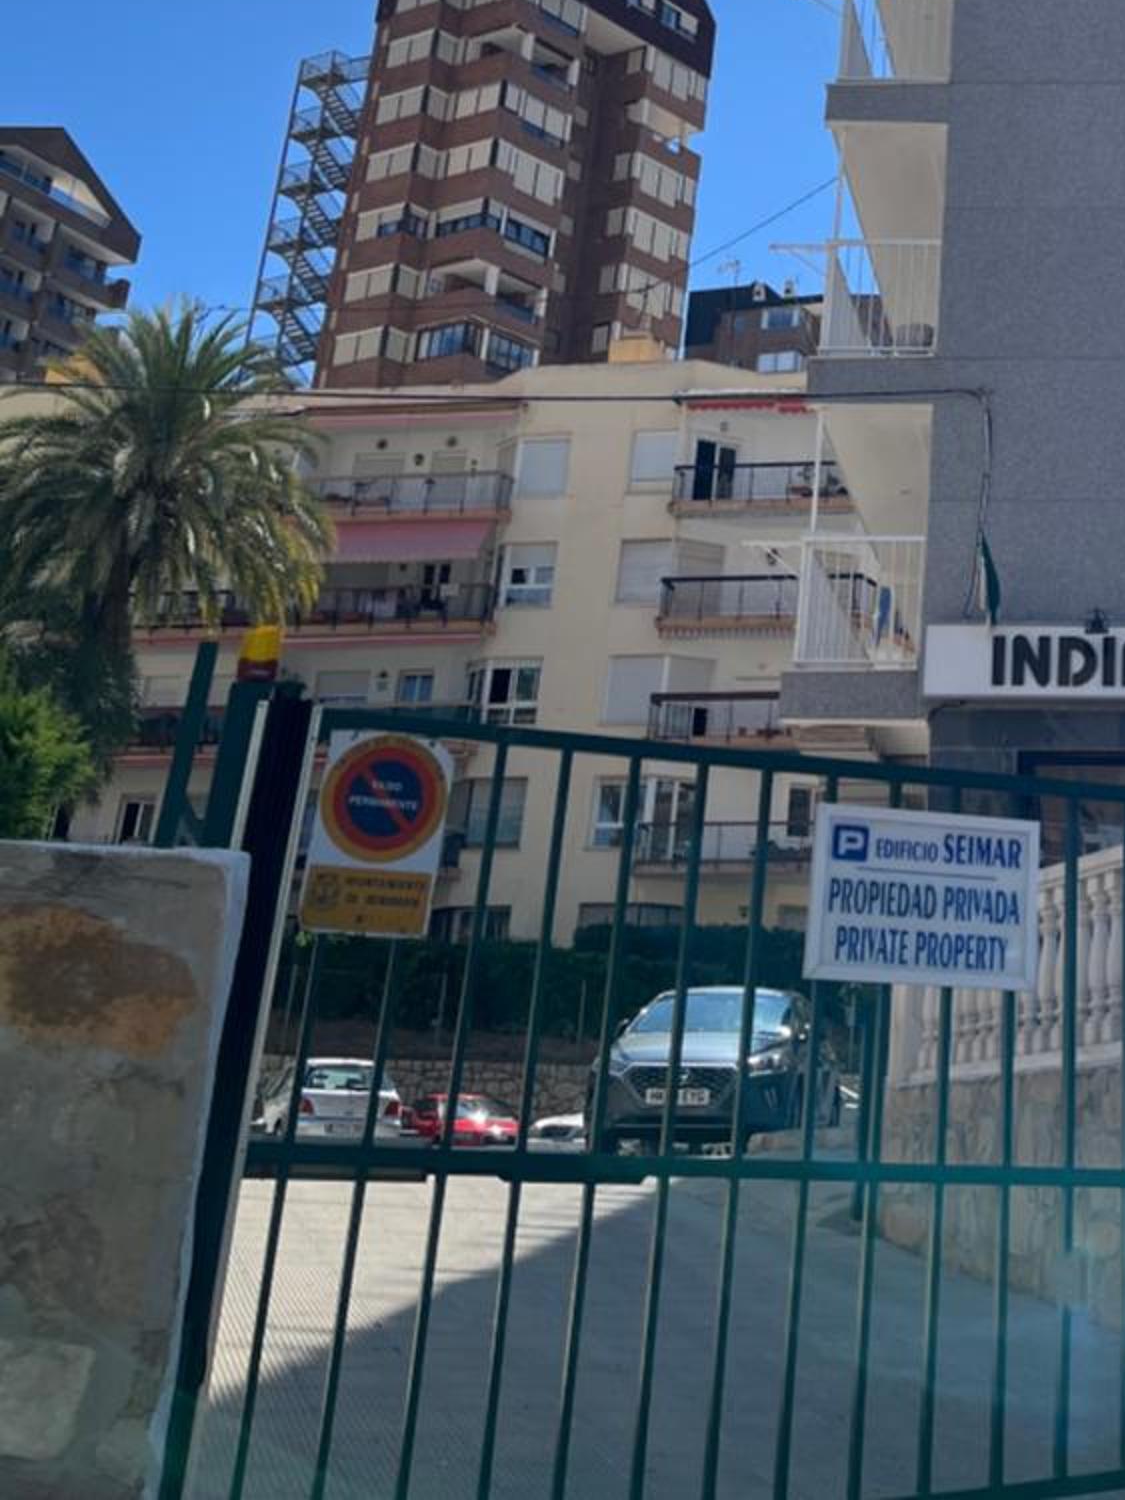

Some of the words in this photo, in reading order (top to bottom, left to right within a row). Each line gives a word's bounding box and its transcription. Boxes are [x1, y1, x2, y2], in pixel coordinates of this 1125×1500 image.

[876, 838, 939, 863] EDIFICIO
[943, 833, 1022, 868] SEIMAR
[828, 878, 937, 920] PROPIEDAD
[943, 886, 1020, 925] PRIVADA
[835, 926, 909, 965] PRIVATE
[915, 931, 1008, 972] PROPERTY
